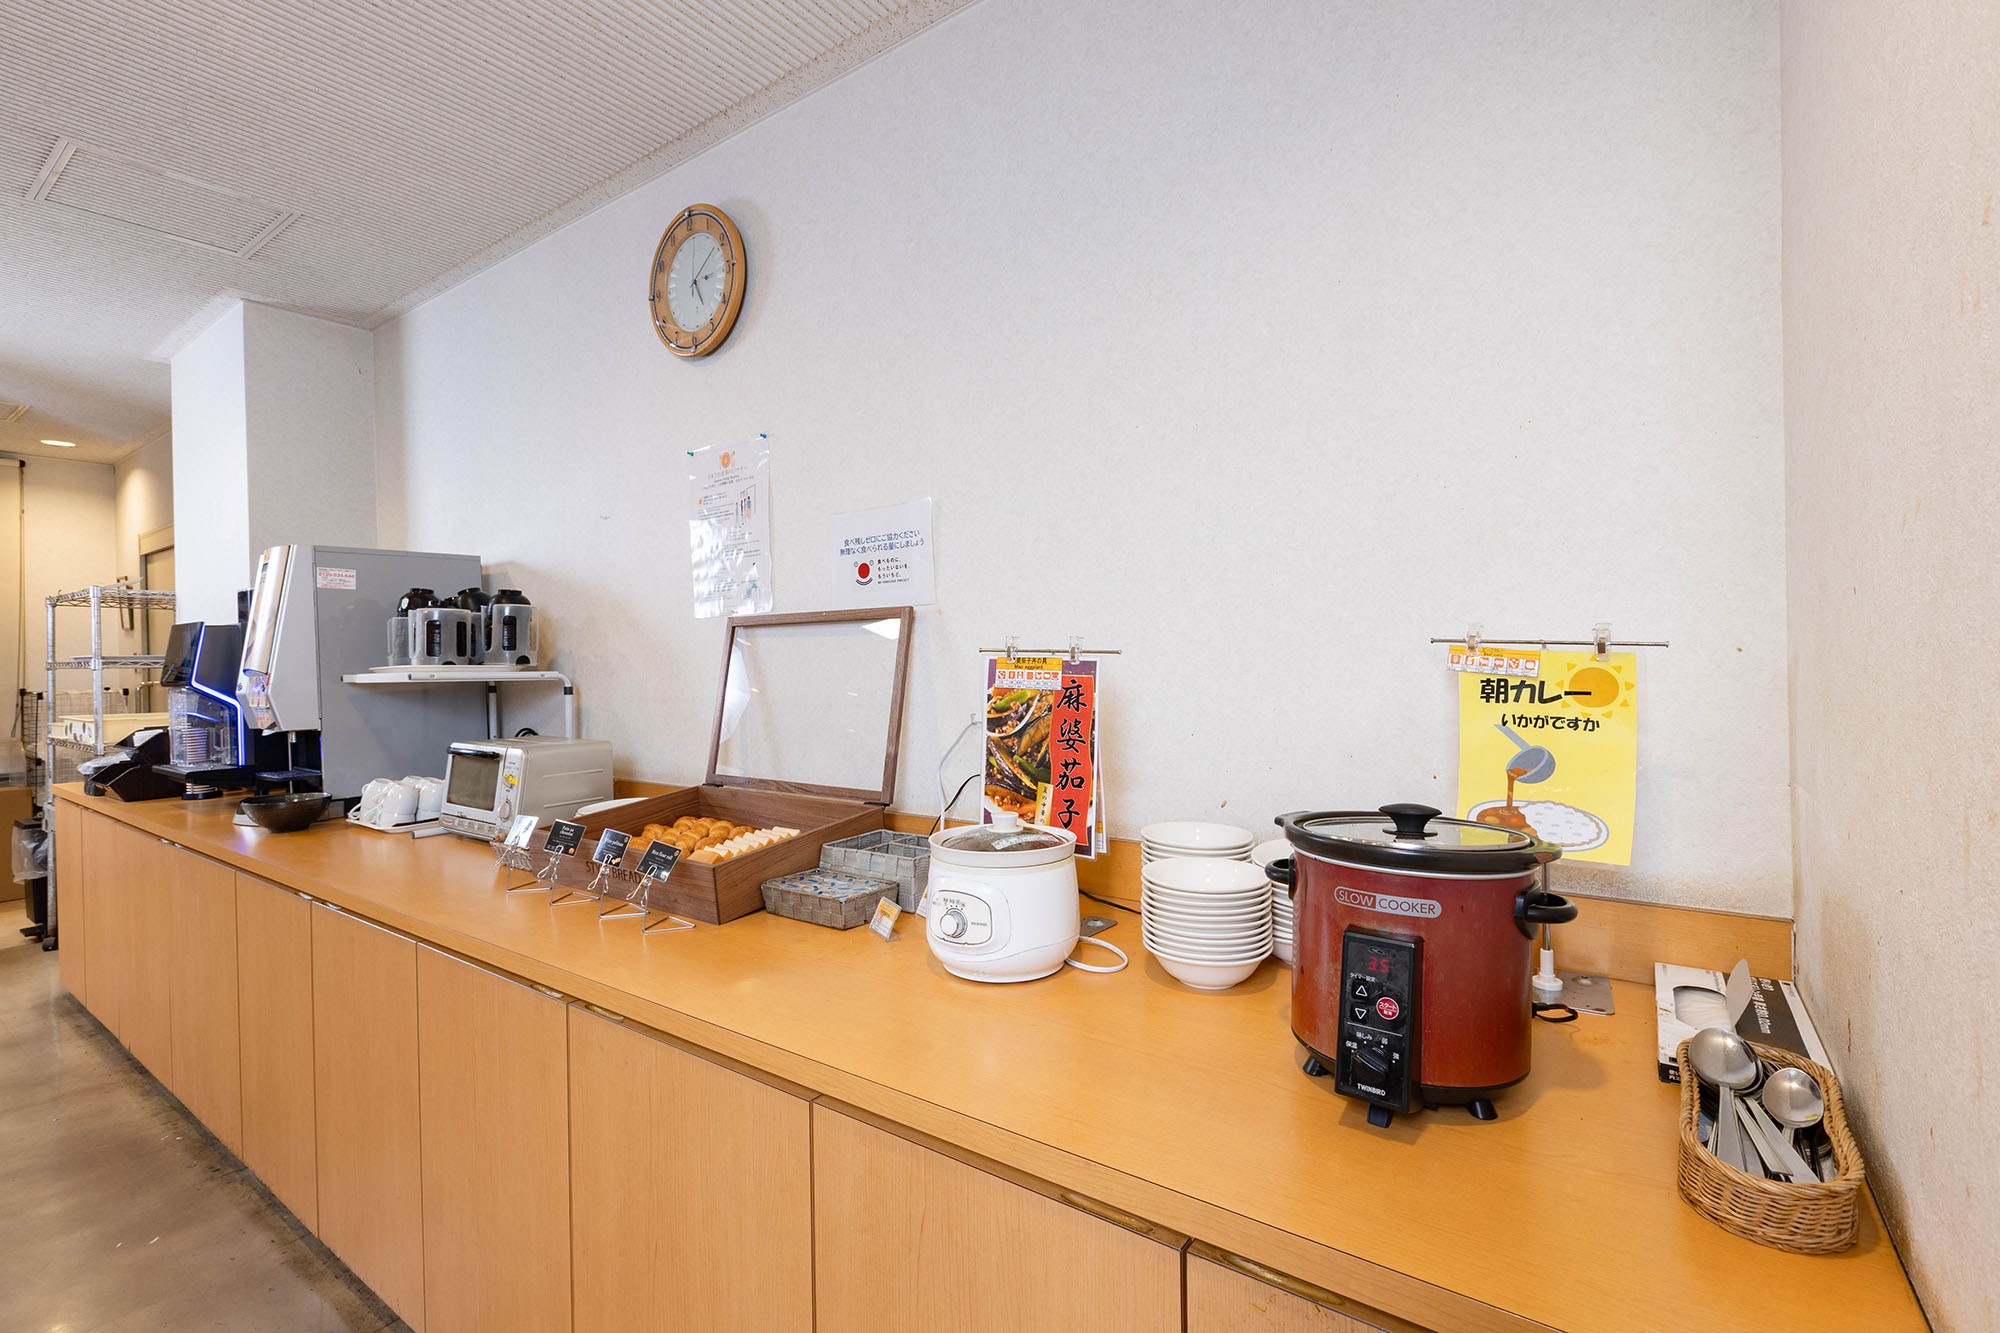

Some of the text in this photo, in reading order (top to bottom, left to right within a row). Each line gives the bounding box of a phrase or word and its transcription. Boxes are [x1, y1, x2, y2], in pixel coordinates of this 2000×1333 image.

[1480, 678, 1592, 704] 朝カレー
[1501, 713, 1600, 732] いかがですか
[1055, 679, 1087, 830] 麻婆茄子
[612, 867, 642, 883] BREAD
[1338, 889, 1436, 915] SLOW COOKER
[1357, 1083, 1386, 1096] TWINBIRD
